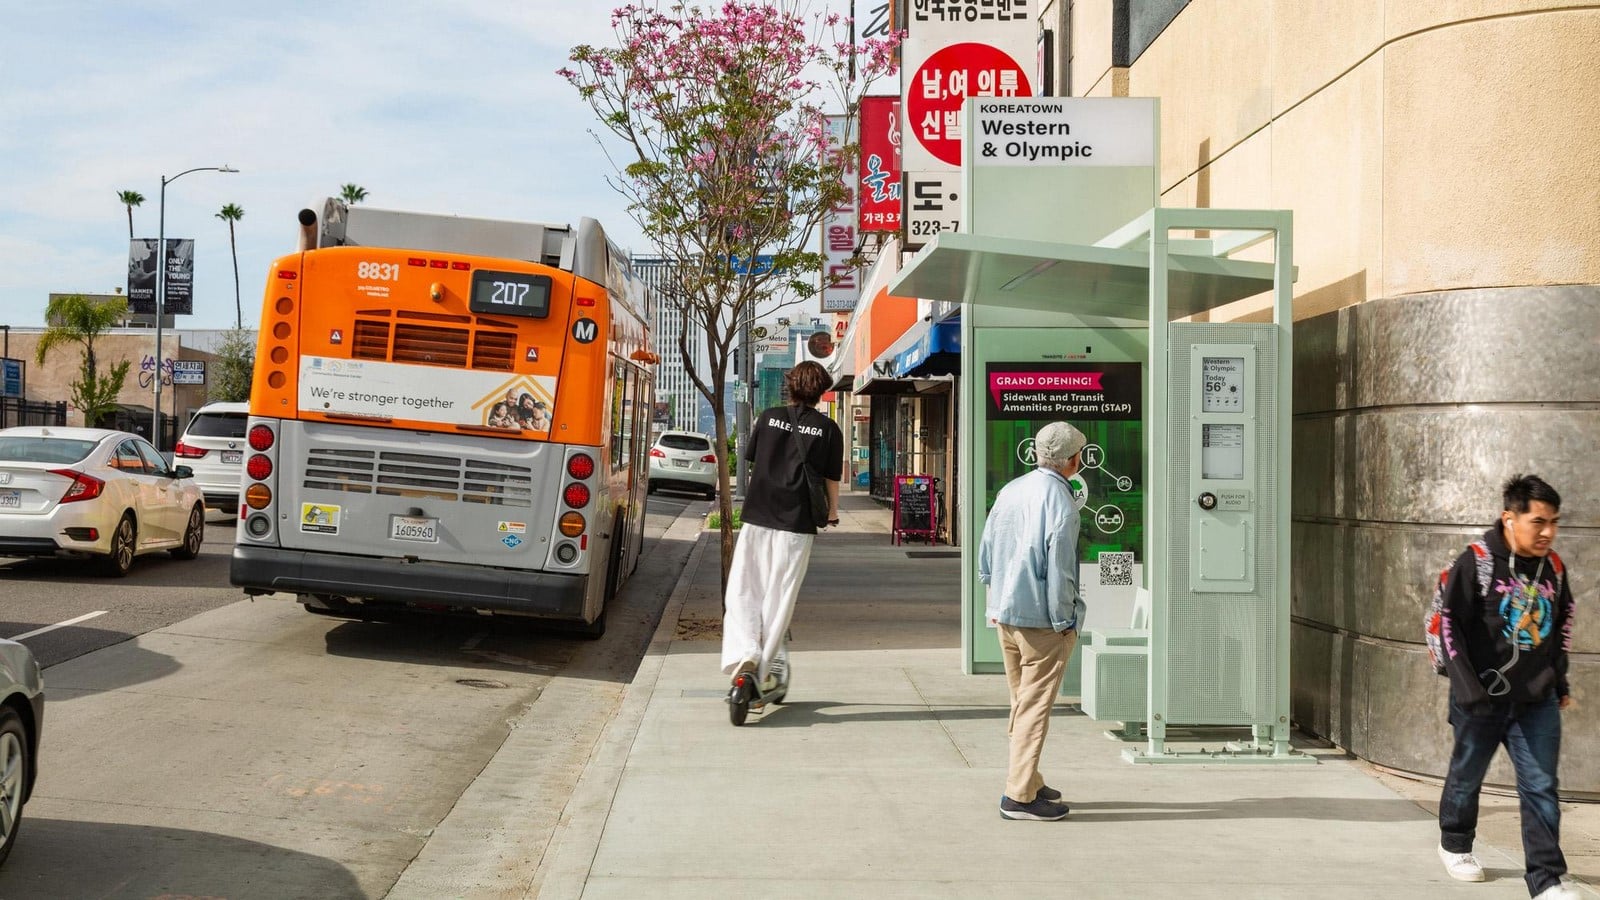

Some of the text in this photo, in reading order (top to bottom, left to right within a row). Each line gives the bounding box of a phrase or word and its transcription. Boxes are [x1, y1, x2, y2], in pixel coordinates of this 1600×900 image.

[980, 104, 1063, 114] KOREATOWN
[982, 120, 1070, 135] Western
[982, 141, 1092, 160] & Olympic
[168, 272, 190, 280] YOUNG
[358, 261, 400, 281] 8831
[491, 281, 530, 306] 207
[575, 321, 596, 341] M
[996, 376, 1092, 386] GRAND OPENING!
[1205, 374, 1226, 382] Today
[310, 386, 455, 410] We're stronger together
[1003, 393, 1105, 402] Sidewalk and Transit
[1003, 403, 1132, 413] Amenities Program (STAP)
[395, 525, 433, 538] 1605960
